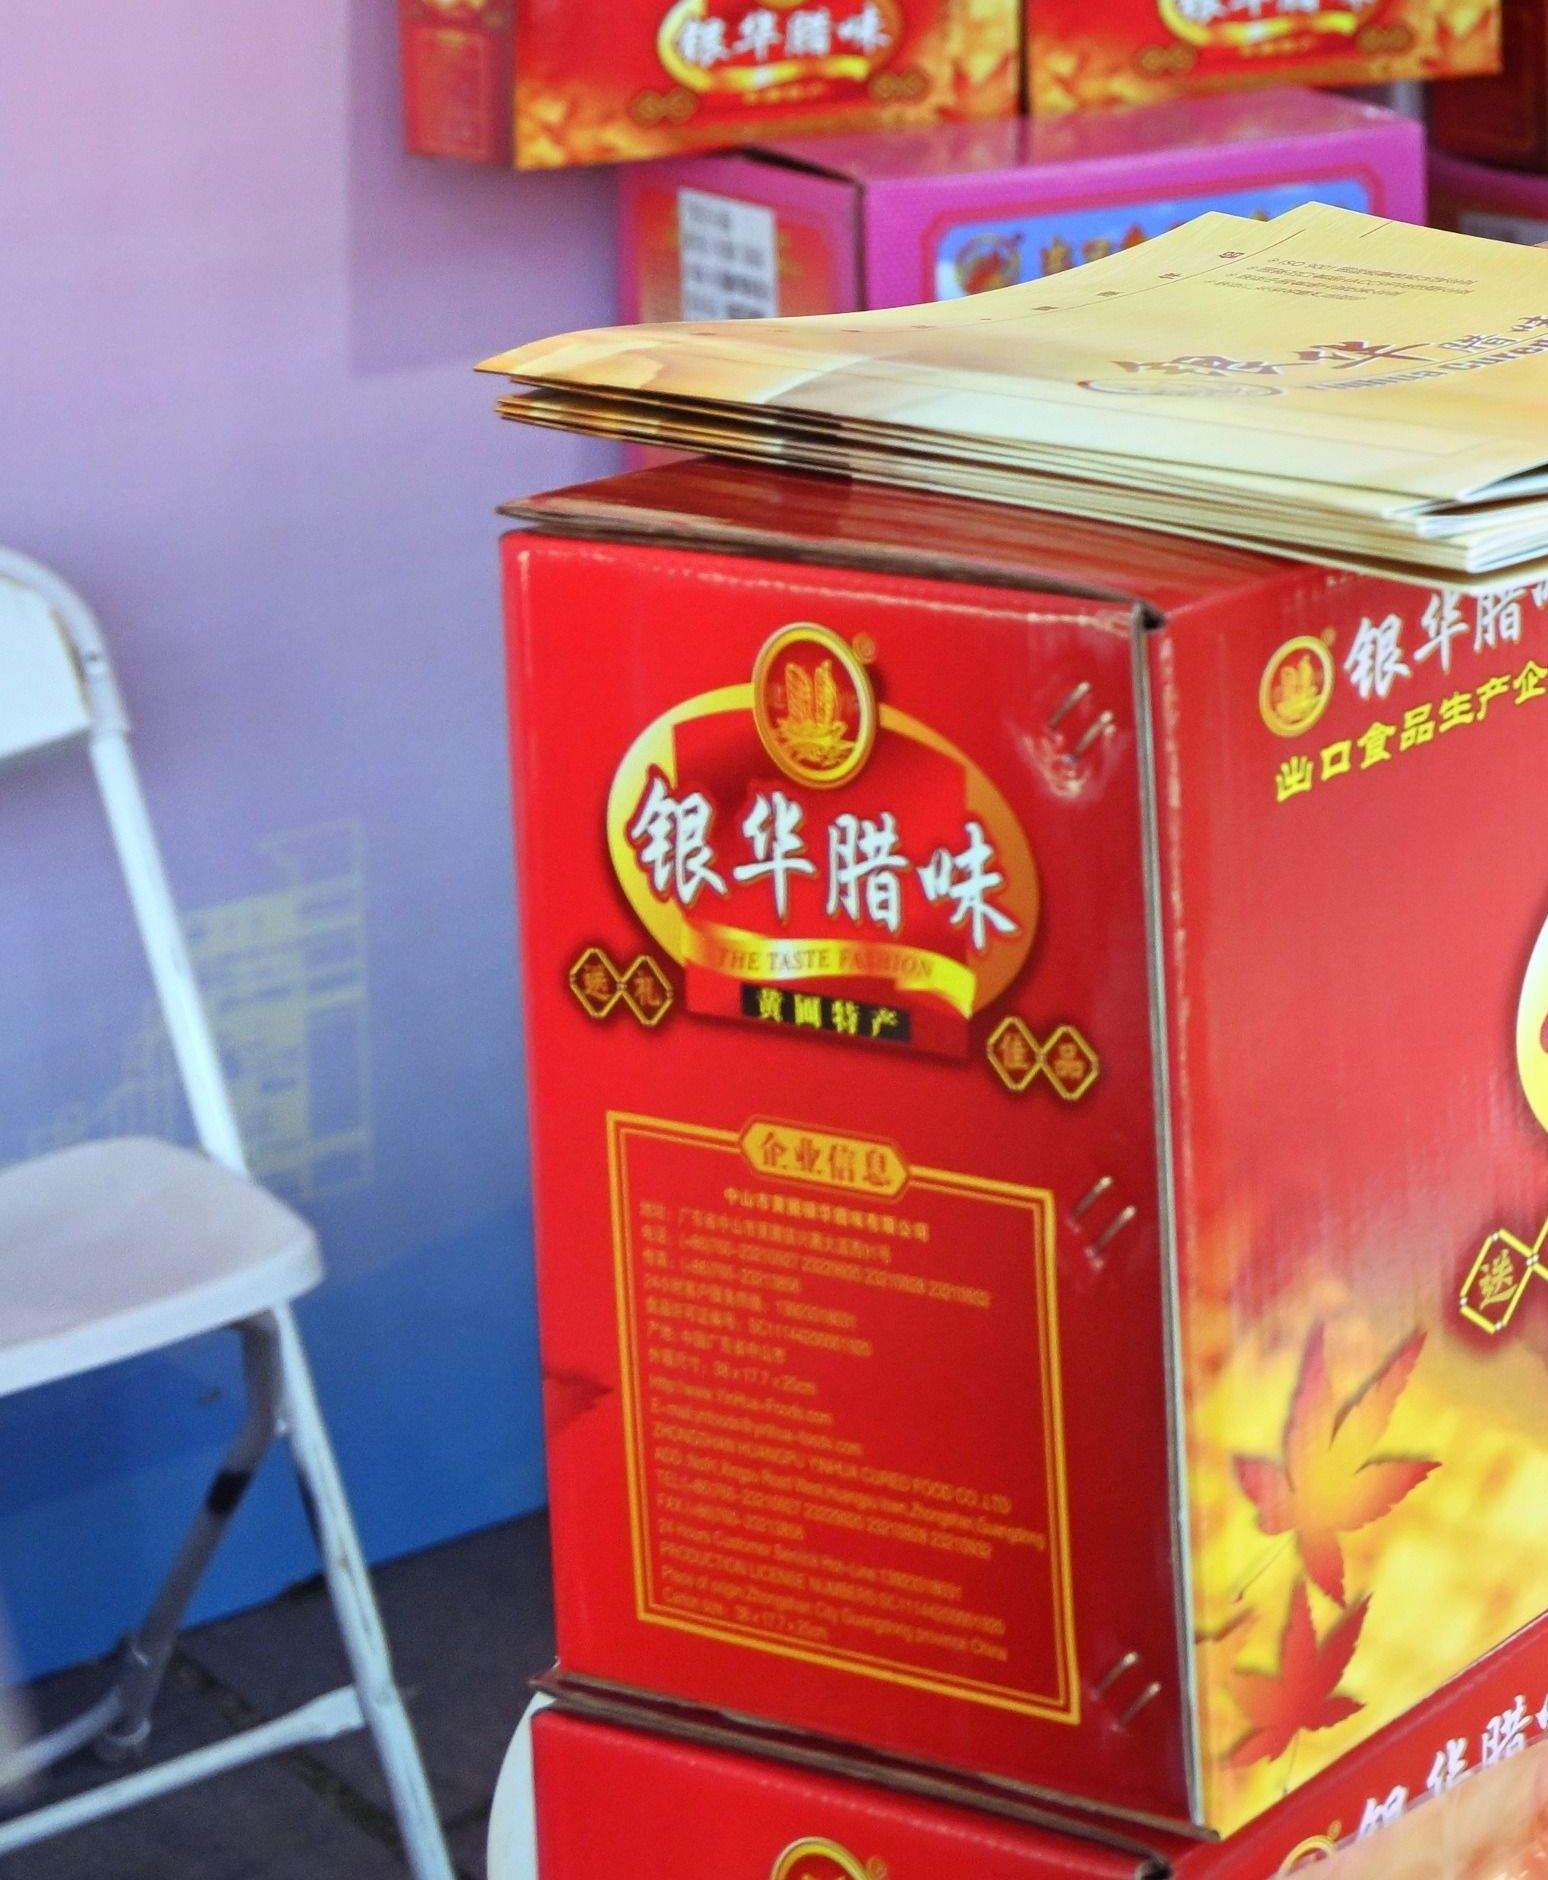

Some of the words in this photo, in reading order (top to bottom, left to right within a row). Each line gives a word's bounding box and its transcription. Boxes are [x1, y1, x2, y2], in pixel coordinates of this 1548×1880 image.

[677, 2, 891, 67] 银华腊味
[628, 772, 1020, 952] 银华腊味
[719, 945, 760, 971] THE
[766, 945, 832, 973] TASTE
[756, 990, 899, 1038] 黄圃特产
[759, 1130, 891, 1188] 企业信息
